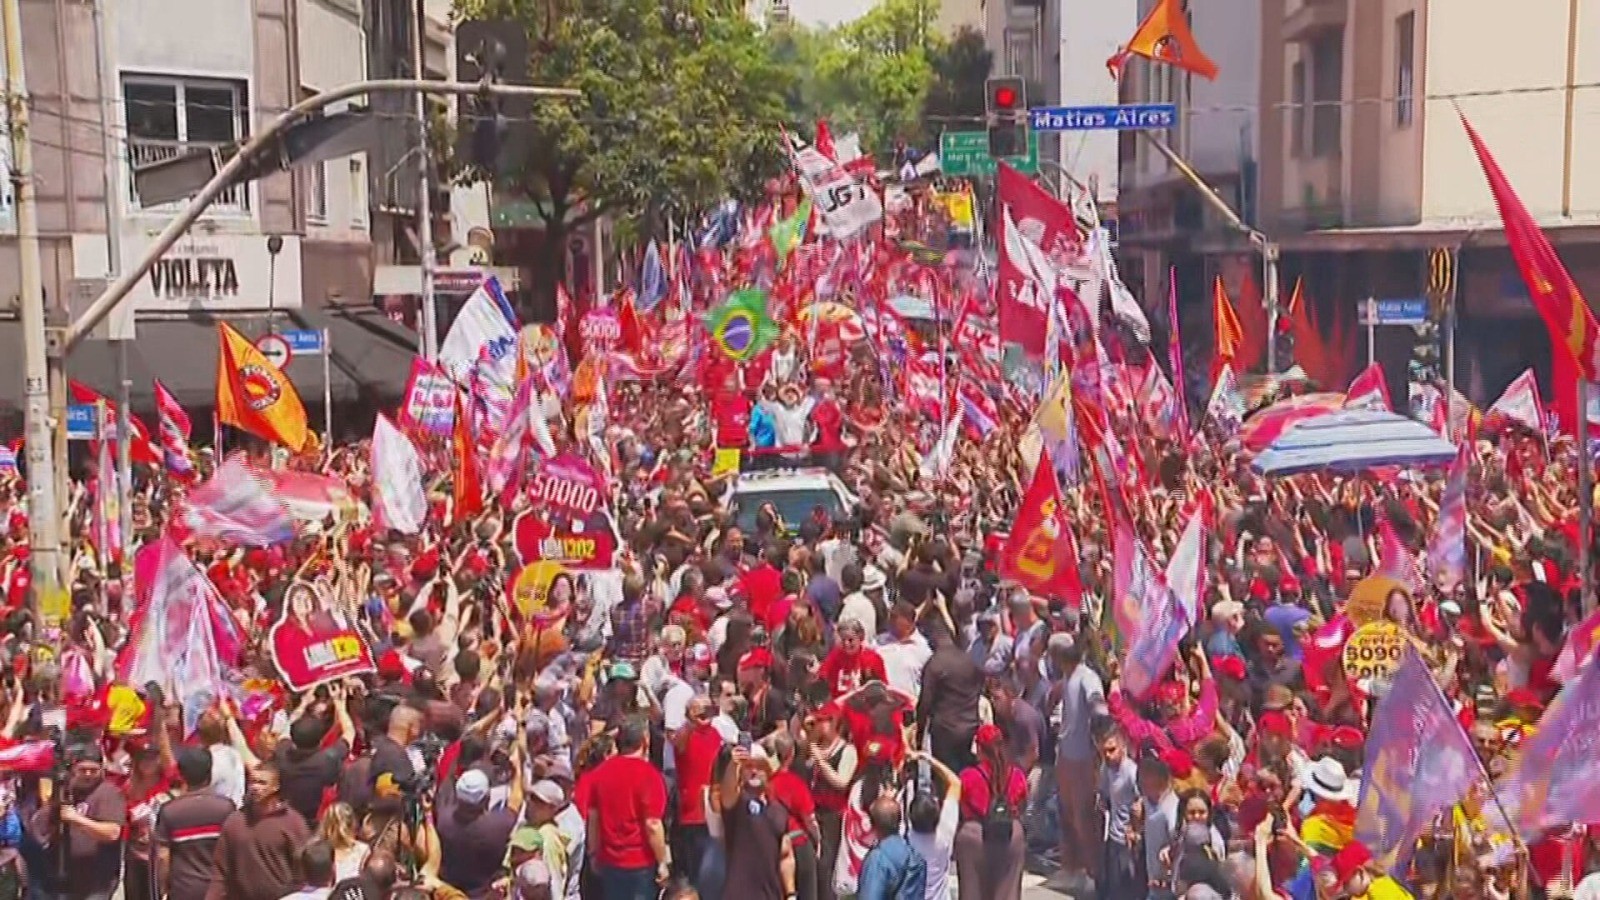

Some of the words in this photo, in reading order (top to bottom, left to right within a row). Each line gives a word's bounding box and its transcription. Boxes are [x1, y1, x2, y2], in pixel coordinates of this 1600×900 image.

[1034, 111, 1106, 128] Matias
[1114, 110, 1172, 126] Aires
[150, 258, 239, 298] VIOLETA
[530, 473, 598, 513] 50000
